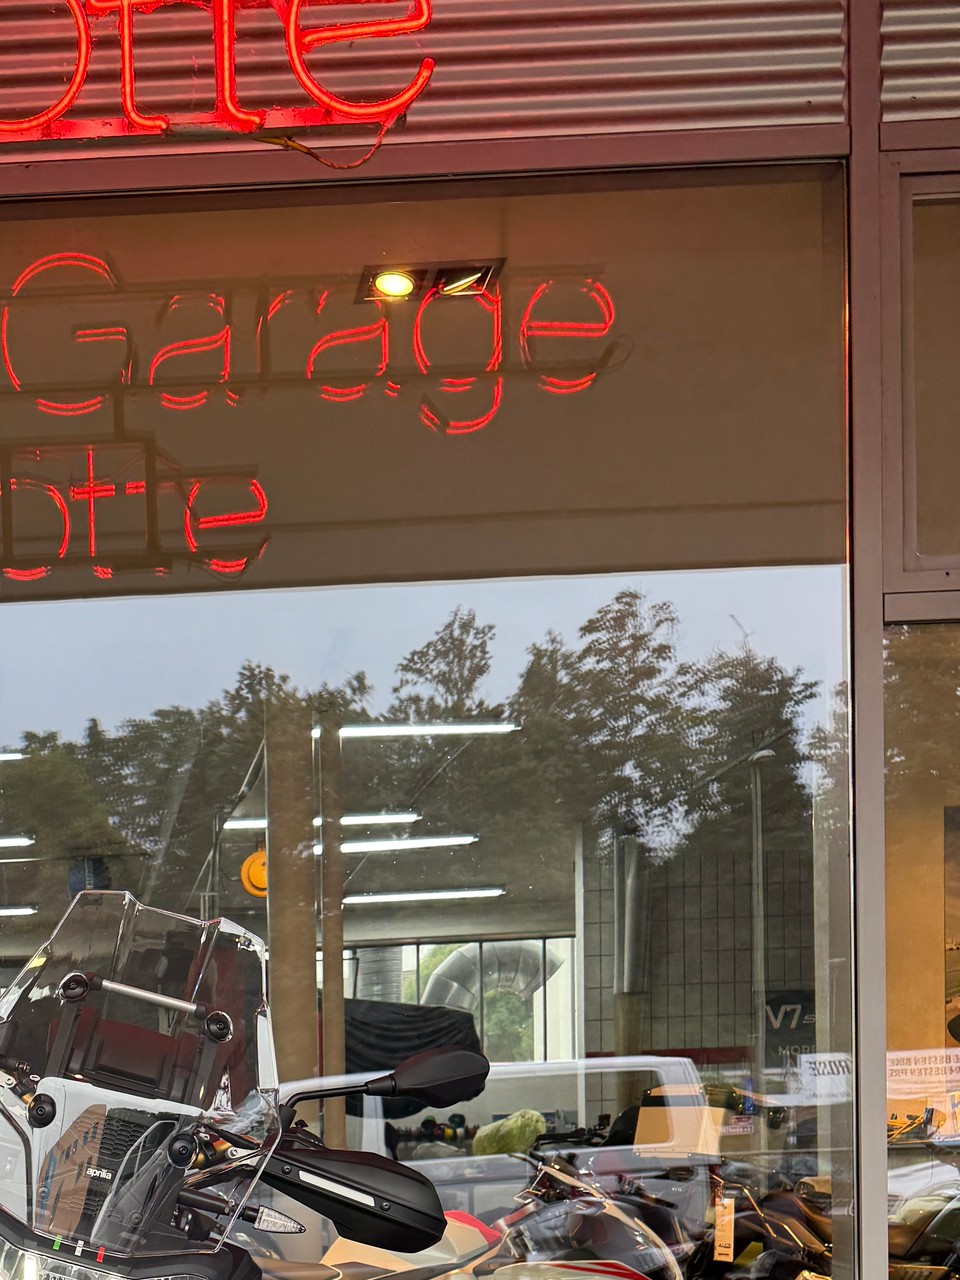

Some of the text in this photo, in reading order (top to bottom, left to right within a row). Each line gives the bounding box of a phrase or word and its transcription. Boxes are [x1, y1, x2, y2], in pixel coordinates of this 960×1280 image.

[0, 252, 616, 434] Garage
[764, 1004, 802, 1030] V7
[86, 1167, 112, 1180] aprilia
